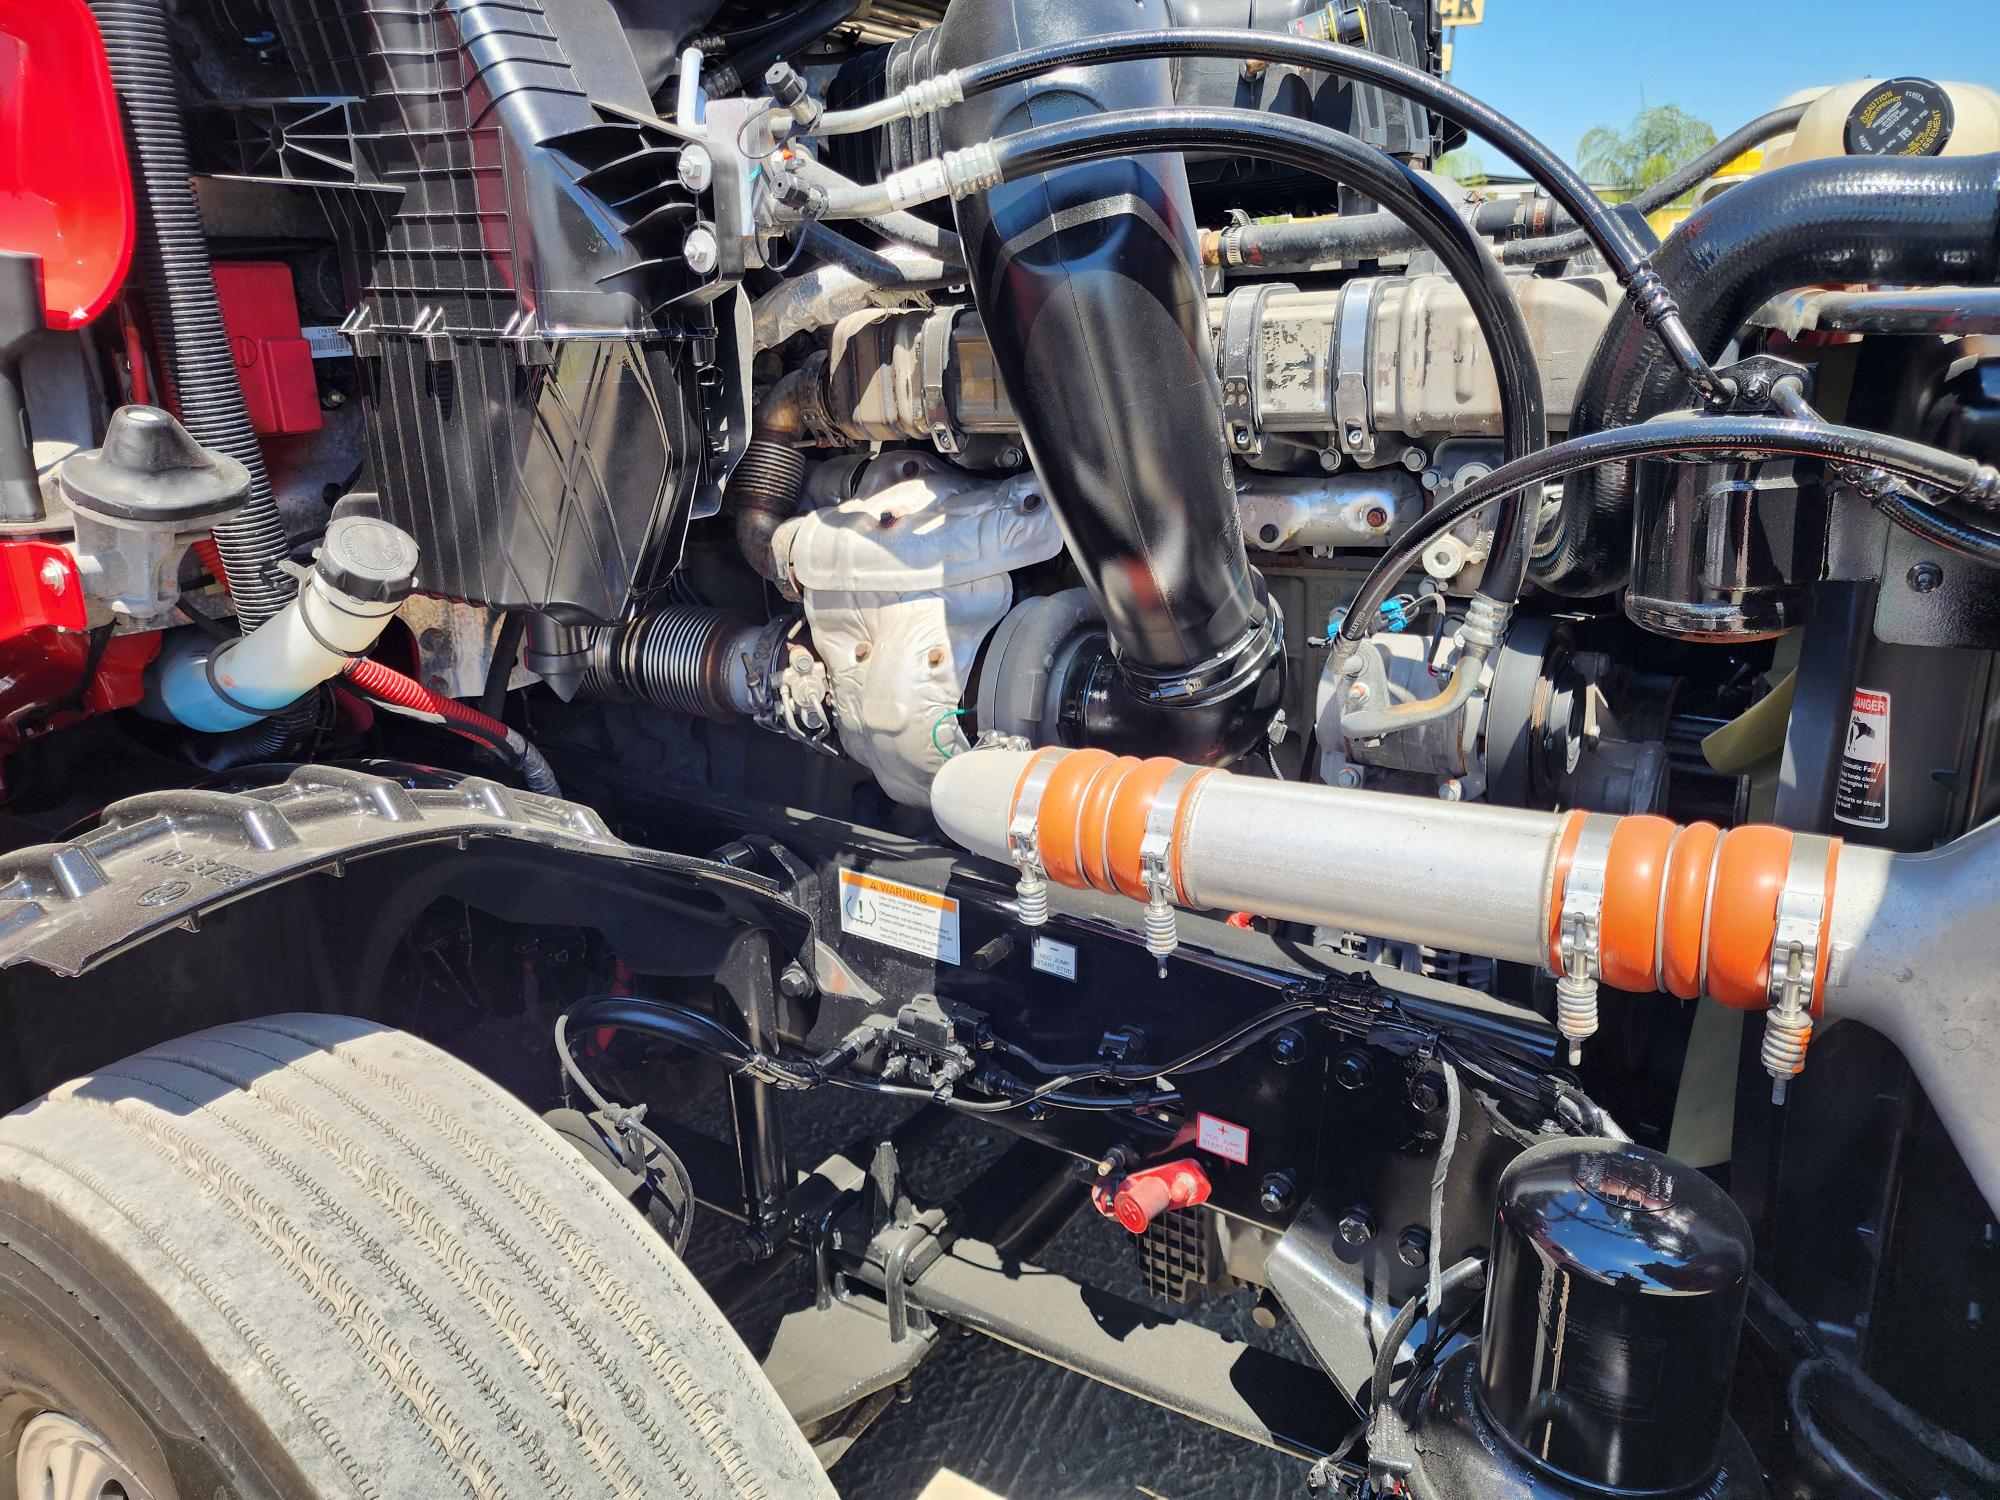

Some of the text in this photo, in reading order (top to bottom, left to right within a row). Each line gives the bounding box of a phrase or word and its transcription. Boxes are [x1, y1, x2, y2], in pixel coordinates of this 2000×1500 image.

[1864, 90, 1892, 115] CAUTION
[1897, 127, 1913, 140] TVS
[1911, 118, 1920, 126] 20
[880, 884, 927, 904] WARNING
